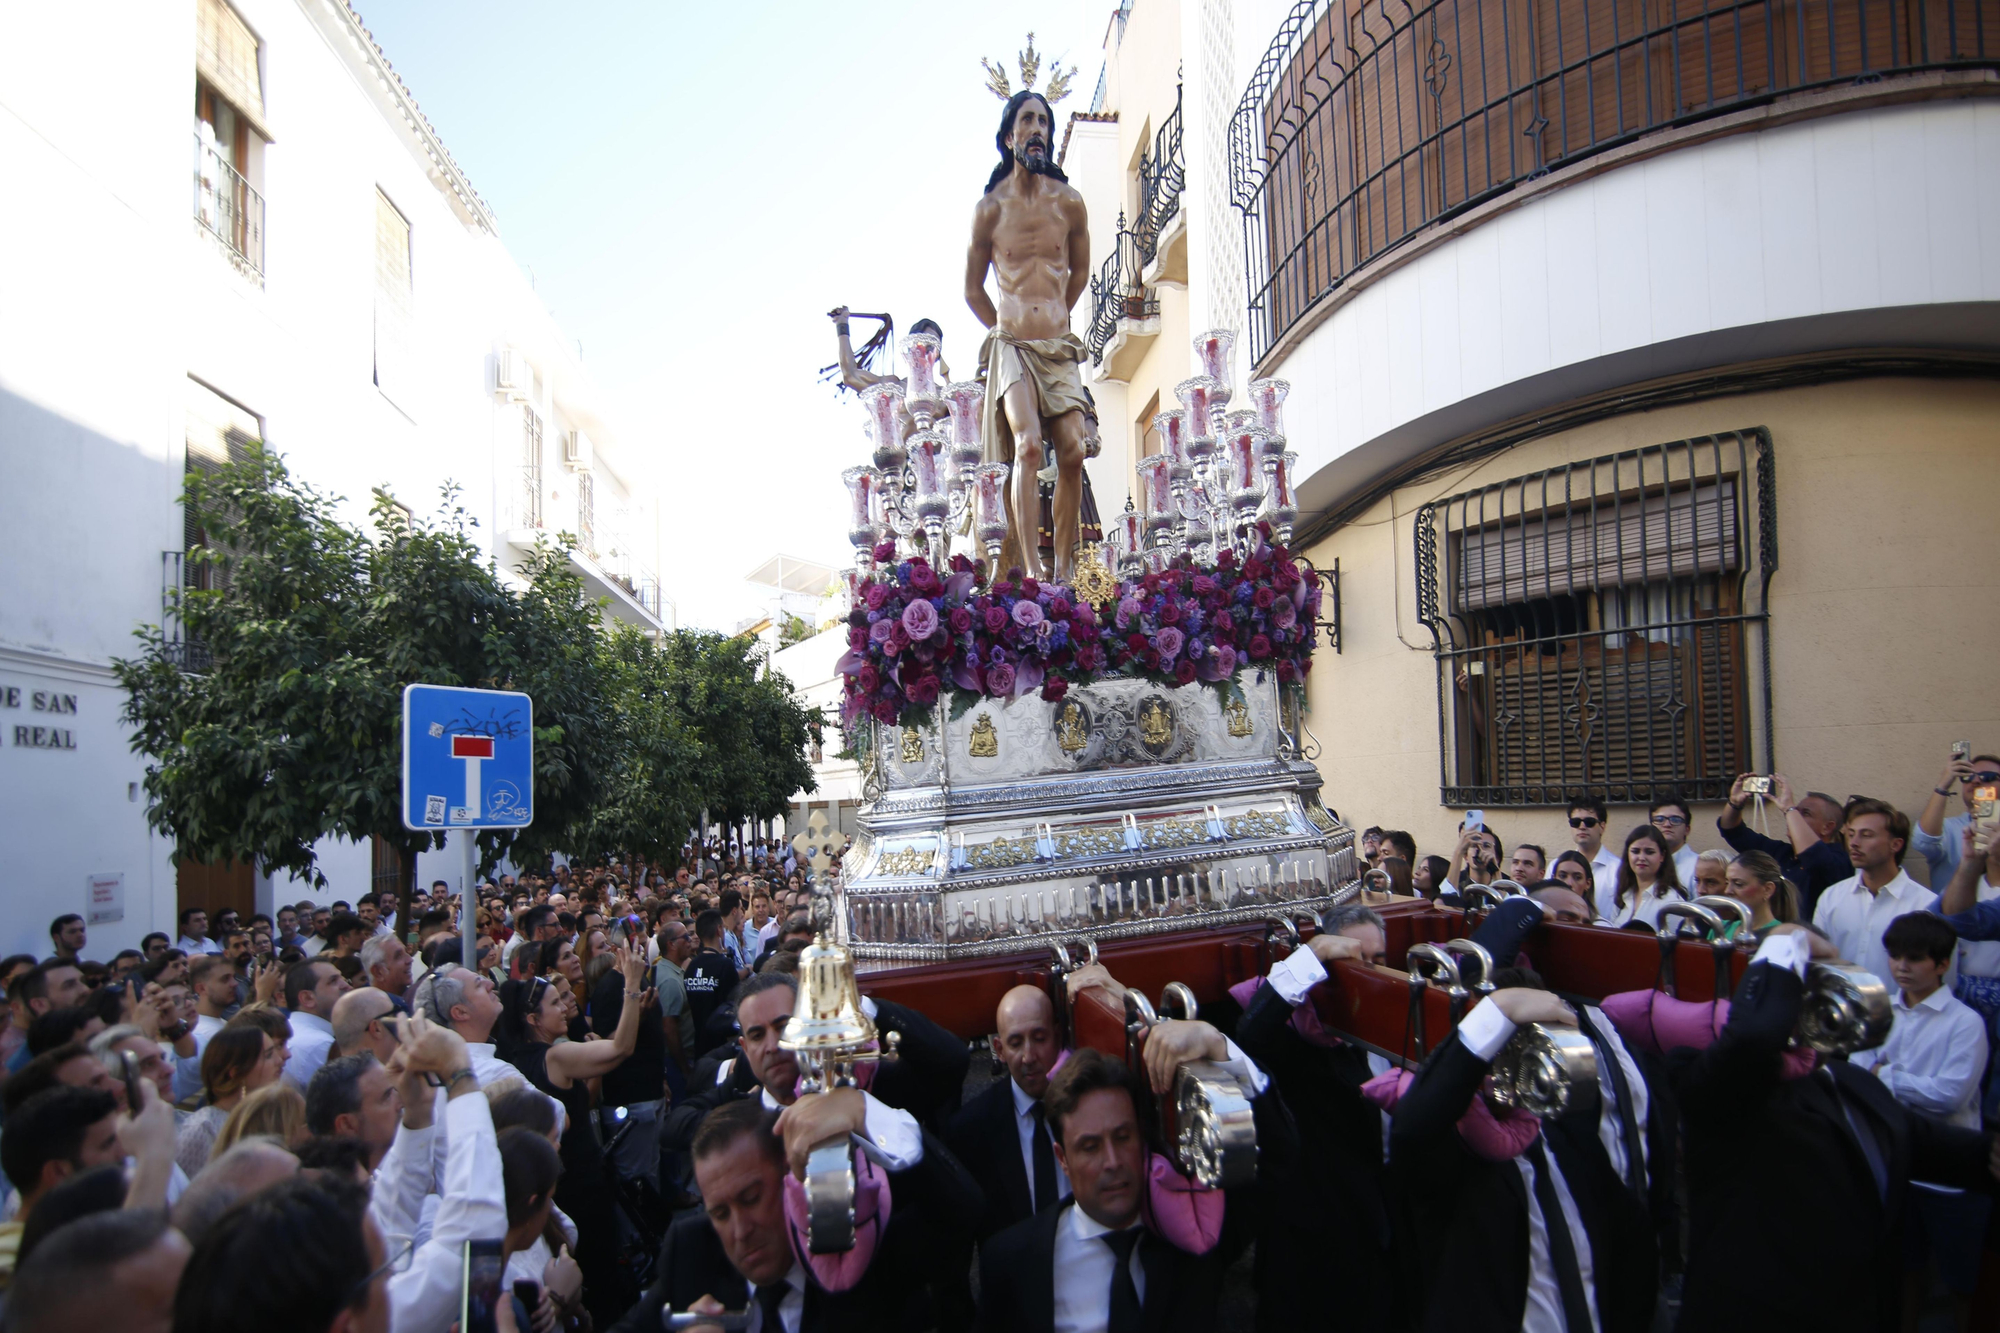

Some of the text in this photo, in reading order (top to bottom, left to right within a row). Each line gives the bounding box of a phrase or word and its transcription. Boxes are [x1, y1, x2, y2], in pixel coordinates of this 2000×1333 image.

[0, 686, 77, 716] E SAN
[15, 725, 77, 750] REAL
